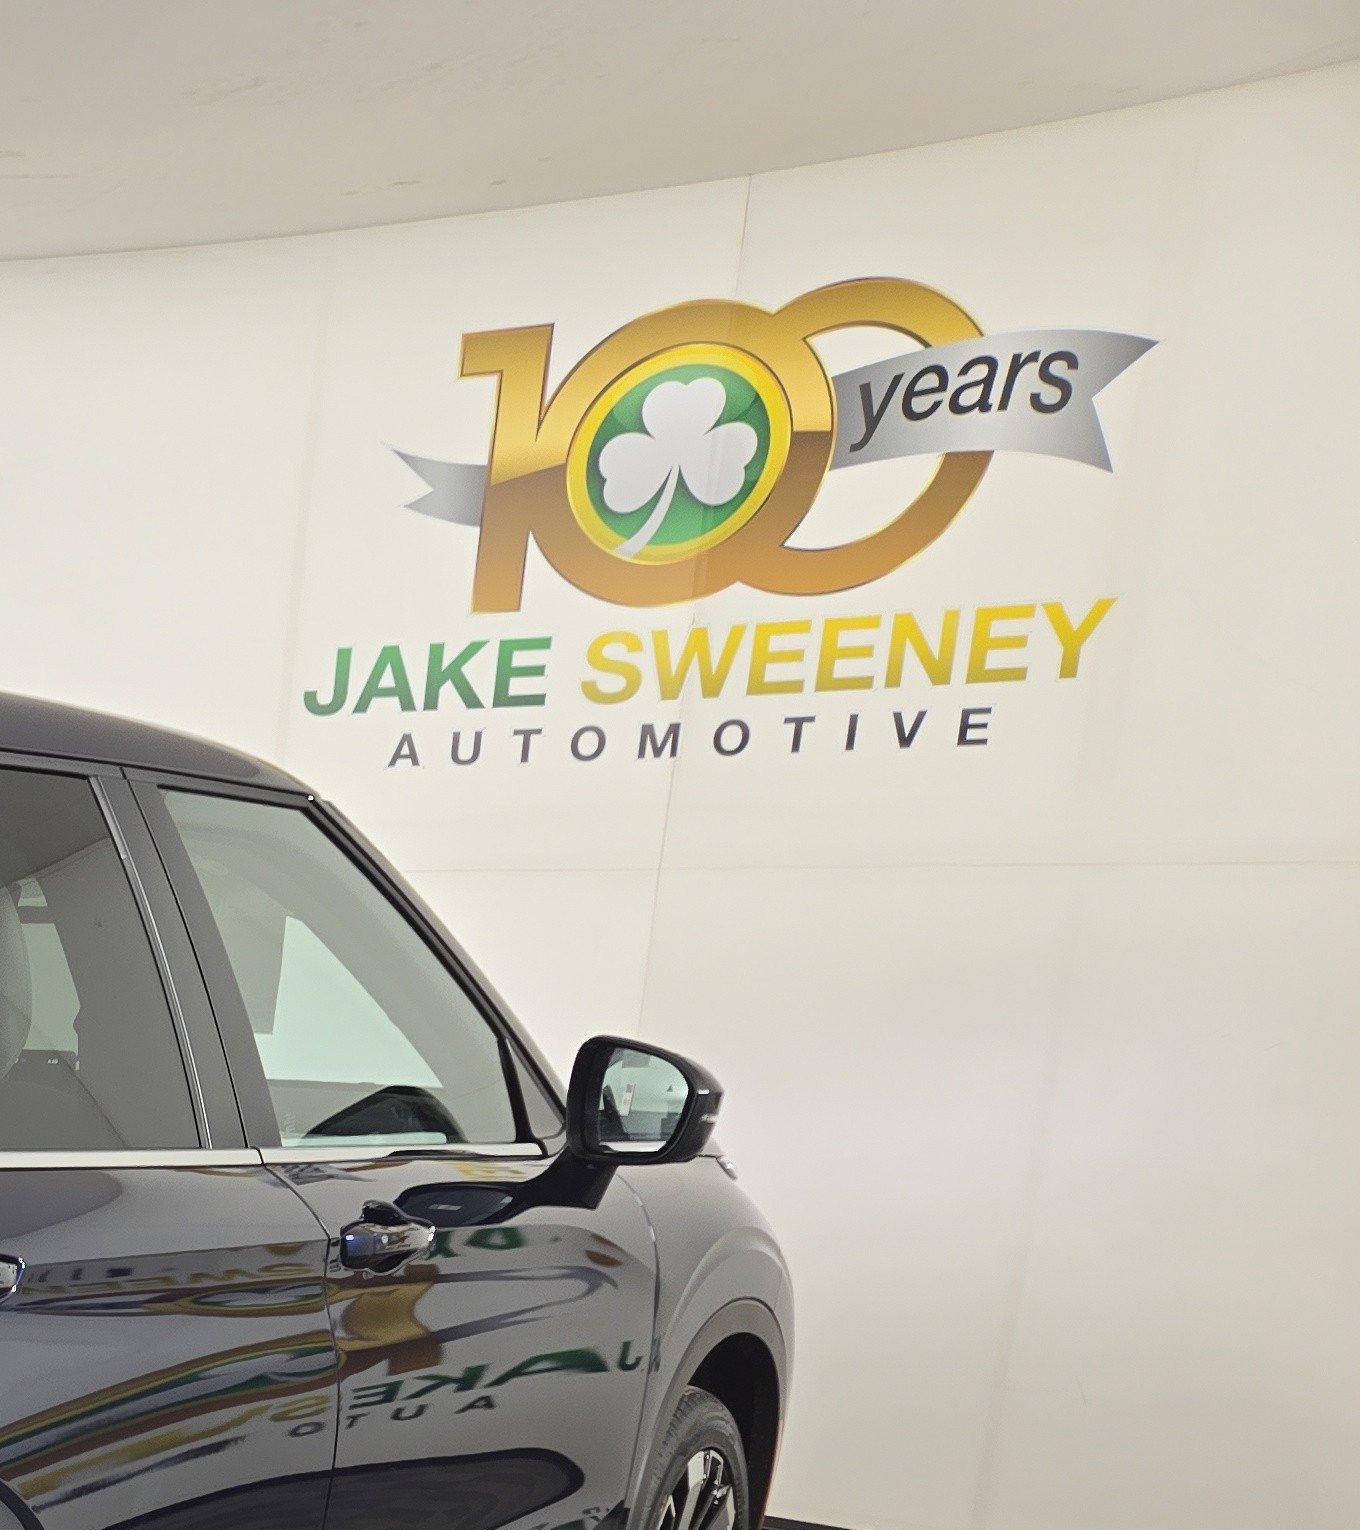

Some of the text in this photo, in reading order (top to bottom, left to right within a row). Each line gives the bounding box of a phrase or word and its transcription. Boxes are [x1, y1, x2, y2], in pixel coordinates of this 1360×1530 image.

[459, 276, 1079, 615] 100 years
[303, 597, 1118, 717] JAKE SWEENEY
[386, 706, 994, 770] AUTOMOTIVE
